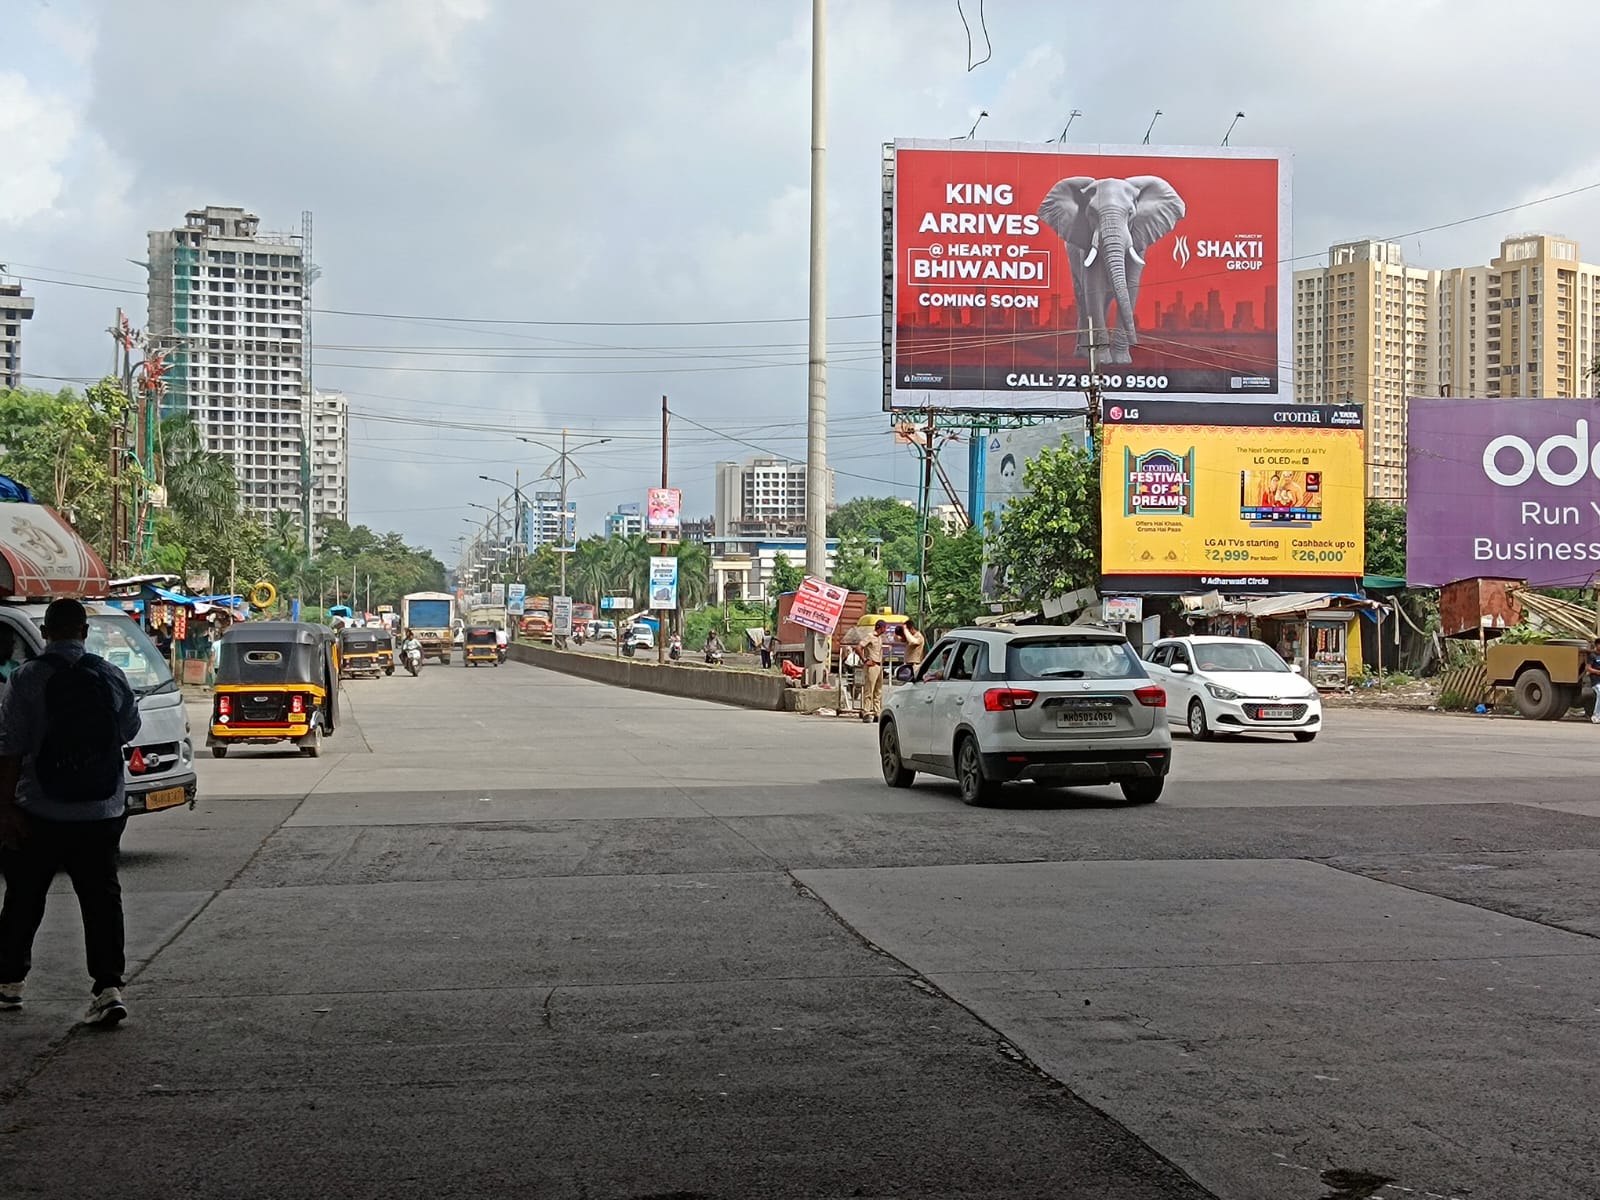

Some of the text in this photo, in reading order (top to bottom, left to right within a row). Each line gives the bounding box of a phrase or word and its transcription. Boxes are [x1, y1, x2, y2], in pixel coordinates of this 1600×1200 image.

[946, 184, 1014, 206] KING
[918, 212, 1040, 236] ARRIVES
[928, 242, 1030, 258] @ HEART OF
[1196, 240, 1263, 258] SHAKTI
[914, 258, 1044, 280] BHIWANDI
[1226, 260, 1262, 270] GROUP
[918, 292, 1039, 308] COMING SOON
[1006, 374, 1053, 386] CALL:
[1057, 374, 1076, 387] 72
[1126, 376, 1168, 388] 9500
[1124, 408, 1139, 418] LG
[1483, 418, 1600, 487] od
[1130, 472, 1190, 482] FESTIVAL
[1151, 484, 1169, 494] OF
[1132, 496, 1188, 506] DREAMS
[1522, 502, 1579, 525] Run
[1246, 539, 1279, 549] starting
[1292, 539, 1332, 547] Cashback
[1474, 537, 1600, 560] Business
